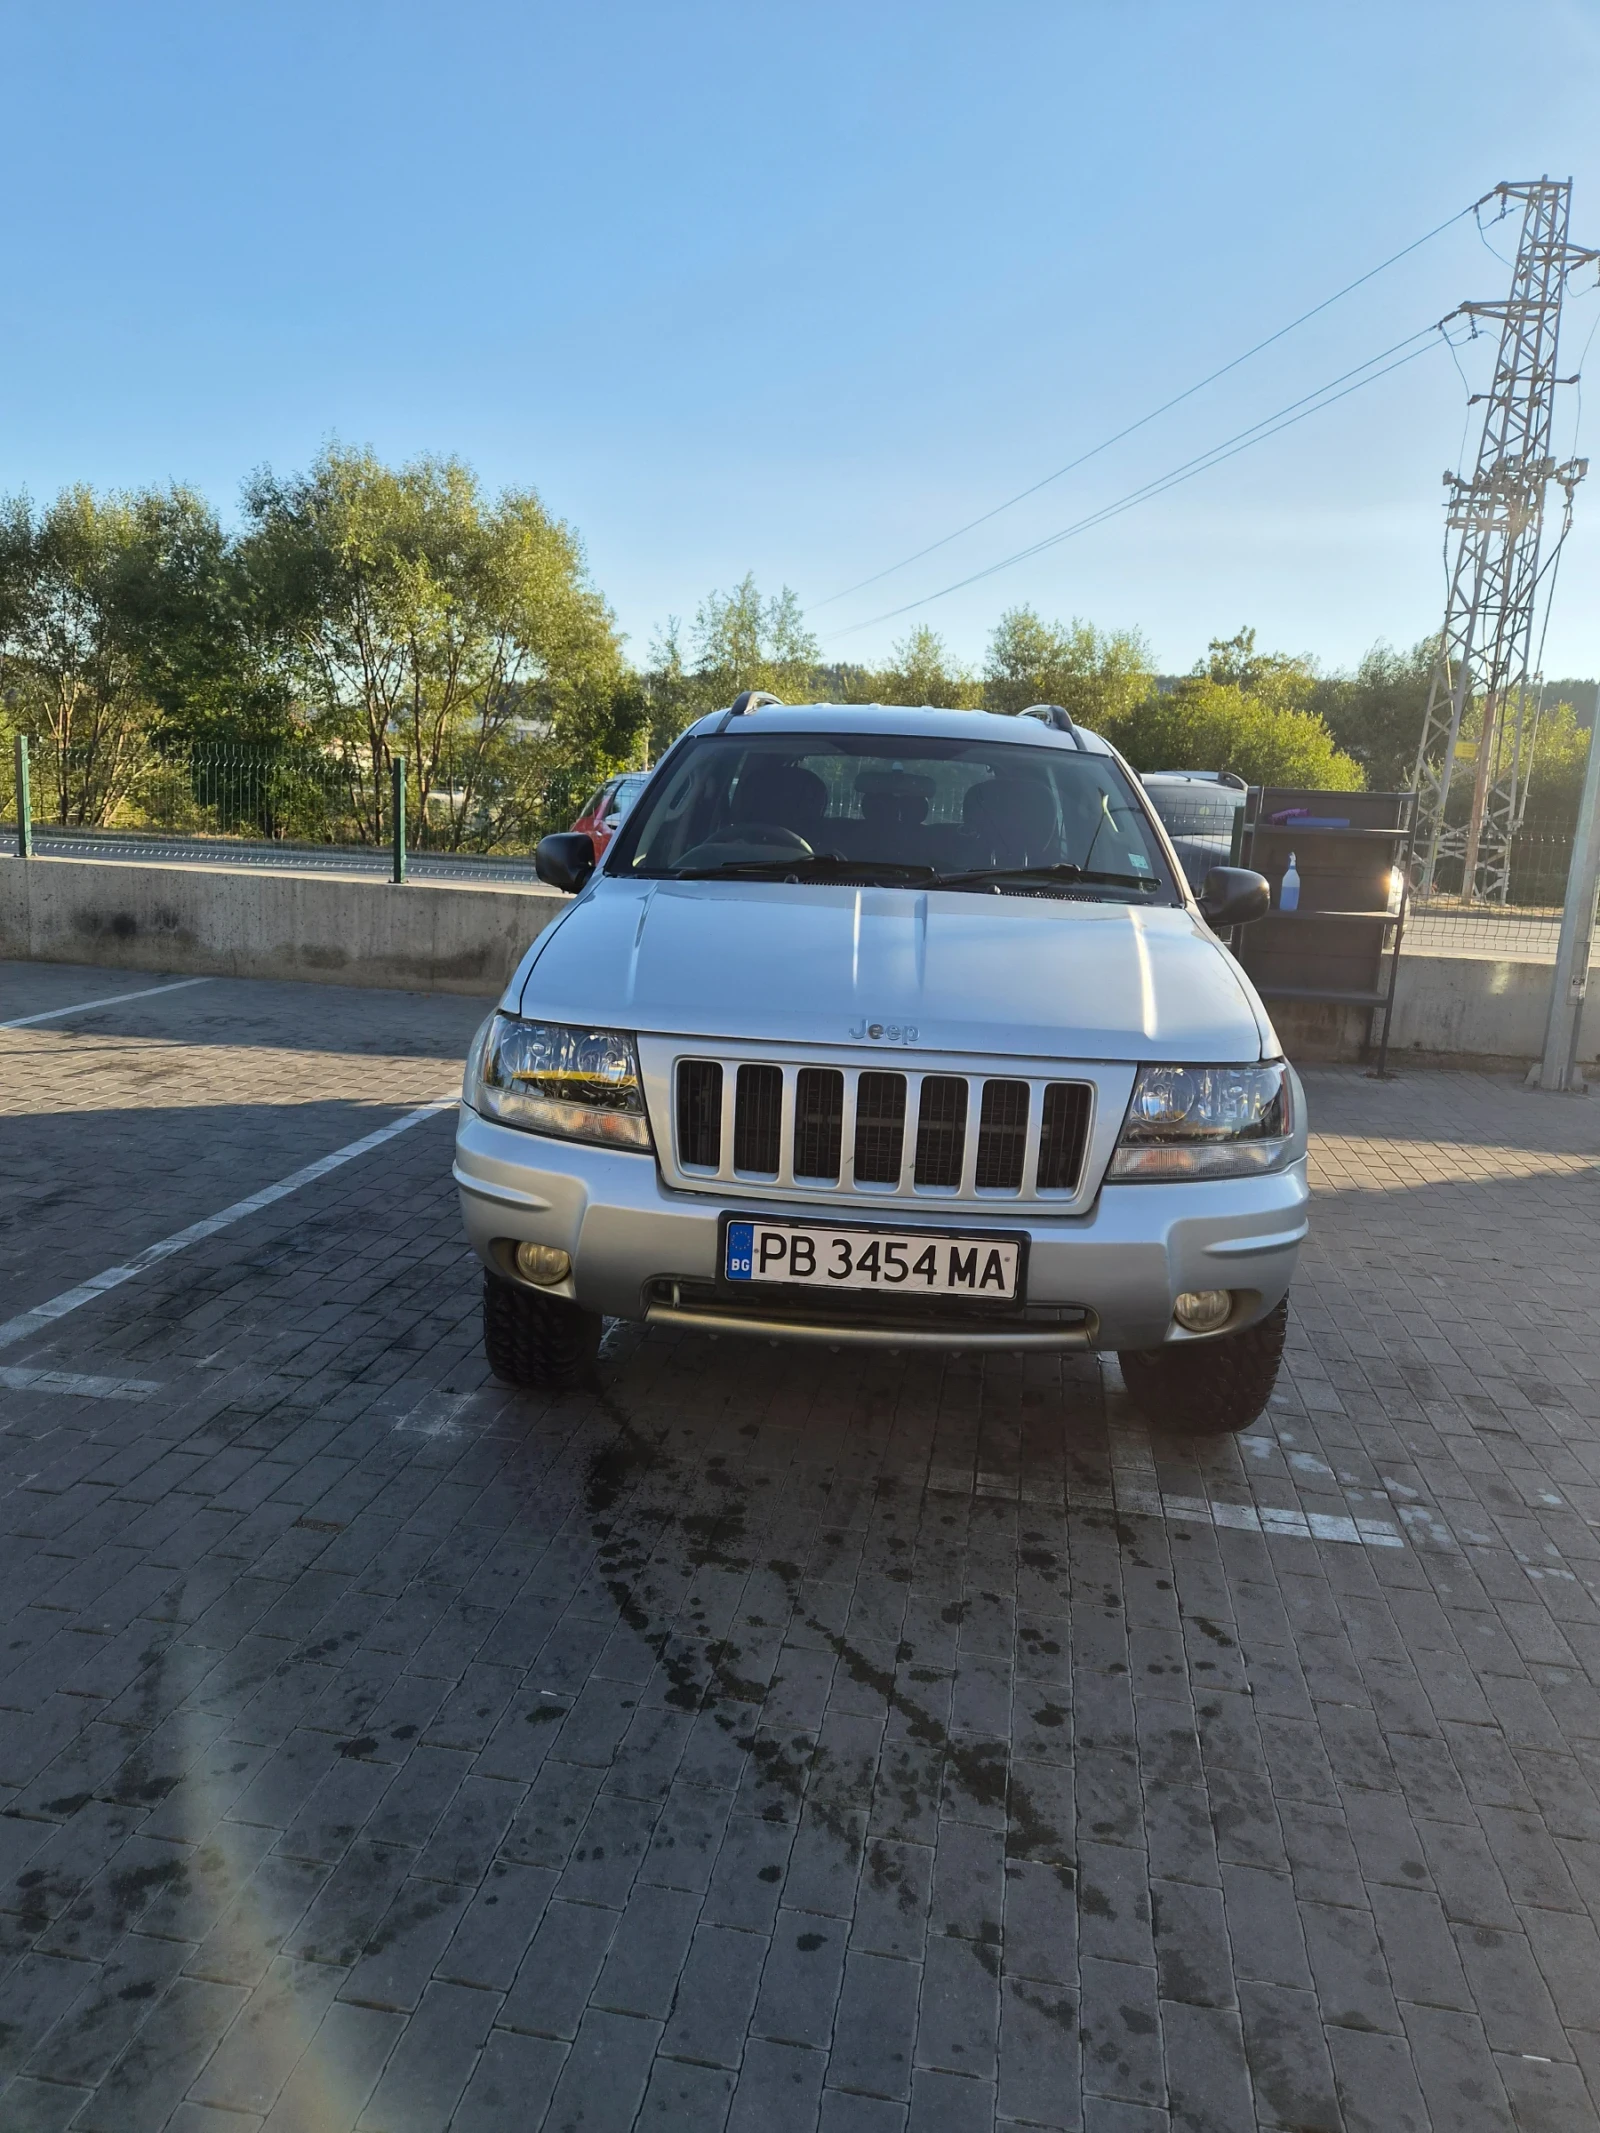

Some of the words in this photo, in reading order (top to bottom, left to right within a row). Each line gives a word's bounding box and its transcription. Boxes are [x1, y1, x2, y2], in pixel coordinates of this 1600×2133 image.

[849, 1019, 920, 1045] Jeep
[731, 1258, 750, 1271] BG
[759, 1233, 817, 1277] PB
[828, 1239, 937, 1285] 3454
[948, 1246, 1005, 1290] MA
